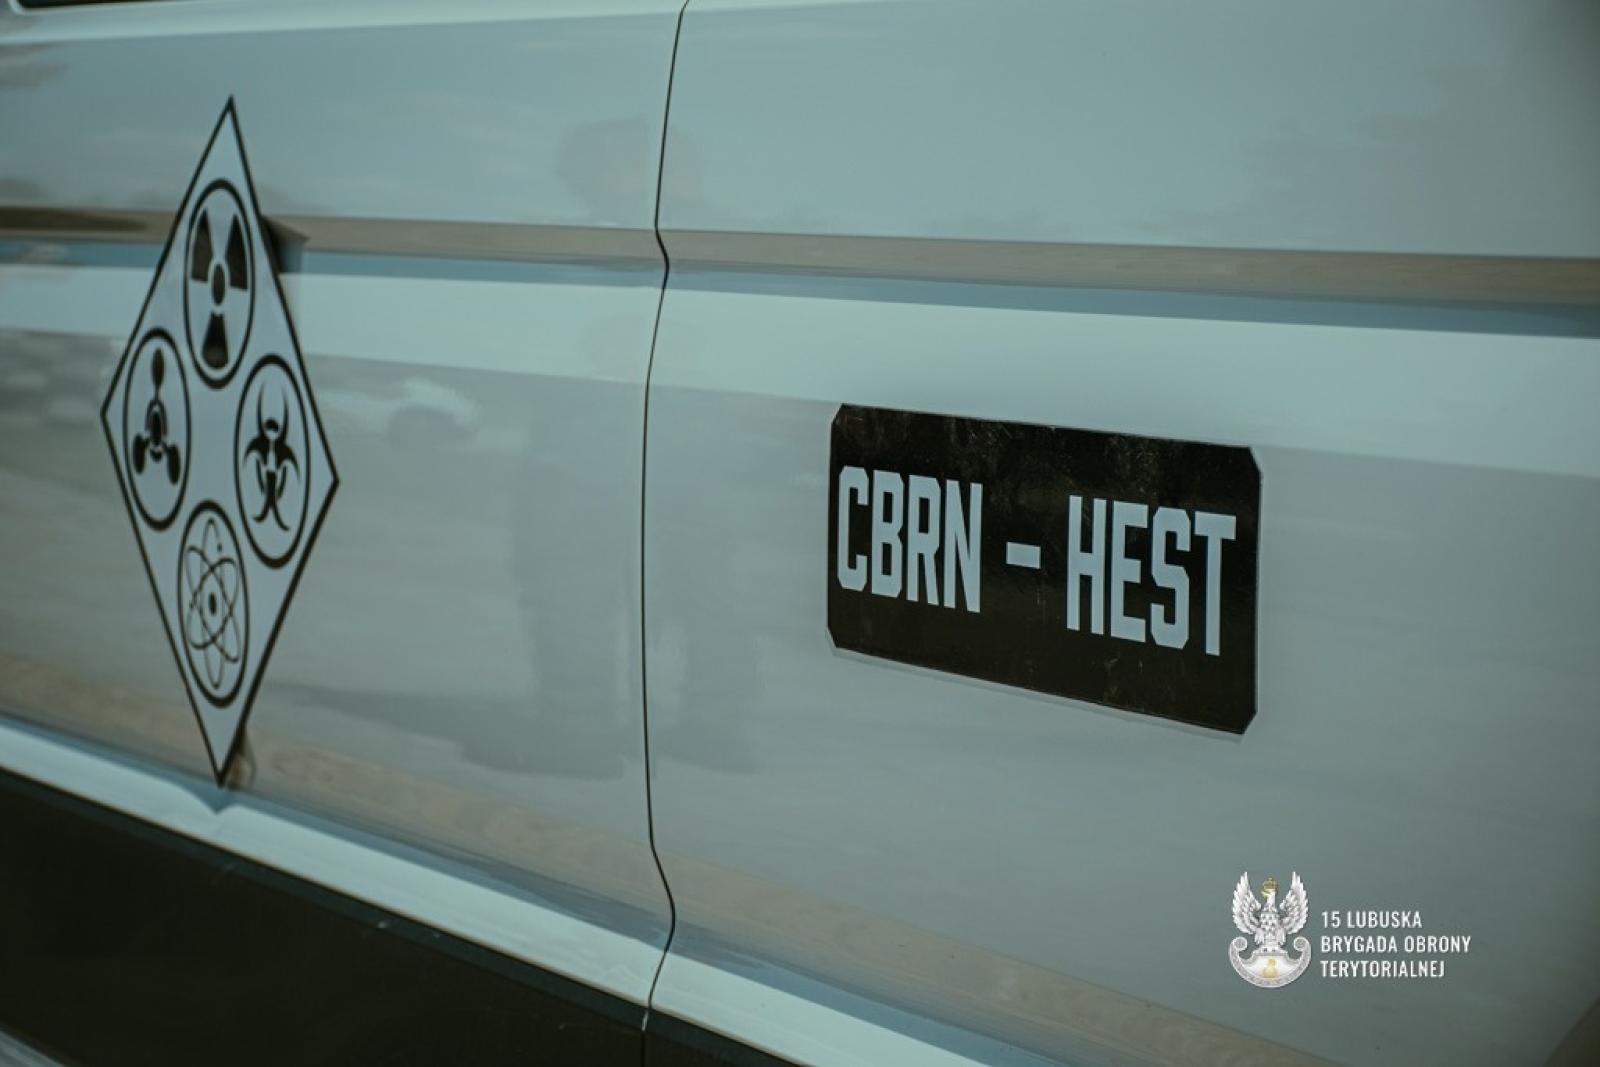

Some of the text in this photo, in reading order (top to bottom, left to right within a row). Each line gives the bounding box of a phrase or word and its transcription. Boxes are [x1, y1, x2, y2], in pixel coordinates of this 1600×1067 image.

[837, 465, 1237, 656] CBRN - HEST
